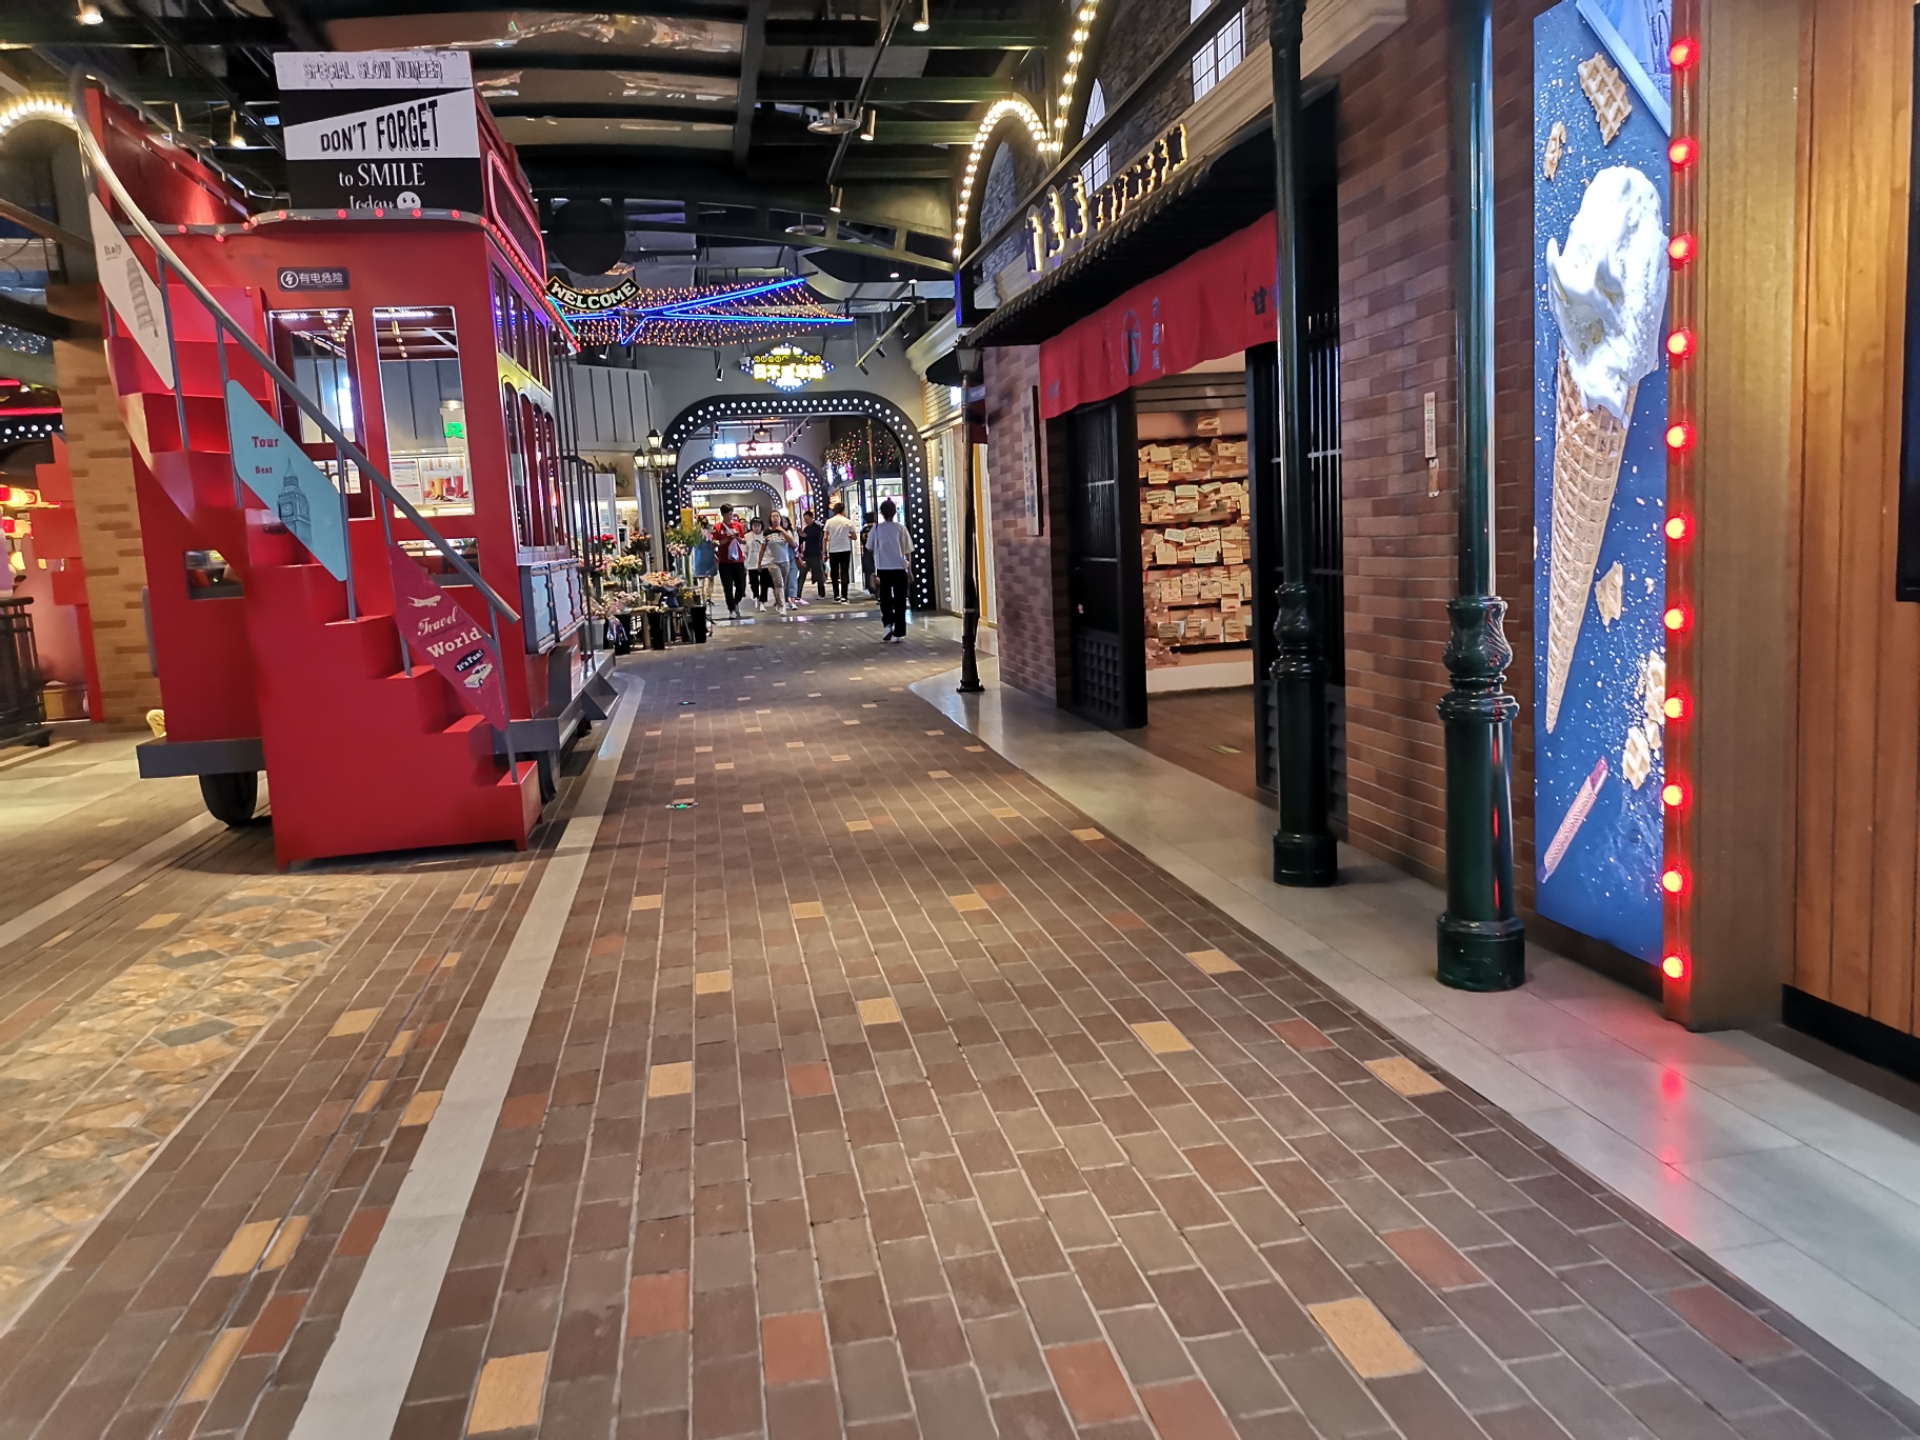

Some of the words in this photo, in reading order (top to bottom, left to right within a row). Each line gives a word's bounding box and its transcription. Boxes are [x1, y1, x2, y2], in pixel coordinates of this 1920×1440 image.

[320, 121, 368, 152] DON'T
[376, 99, 439, 151] FORGET
[338, 171, 354, 187] to
[357, 162, 426, 187] SMILE
[298, 272, 343, 284] 有电危险
[551, 282, 637, 310] WELCOME
[251, 436, 279, 448] Tour
[255, 465, 273, 474] Best
[417, 606, 458, 636] Travel
[426, 627, 482, 658] World
[456, 660, 469, 671] It's
